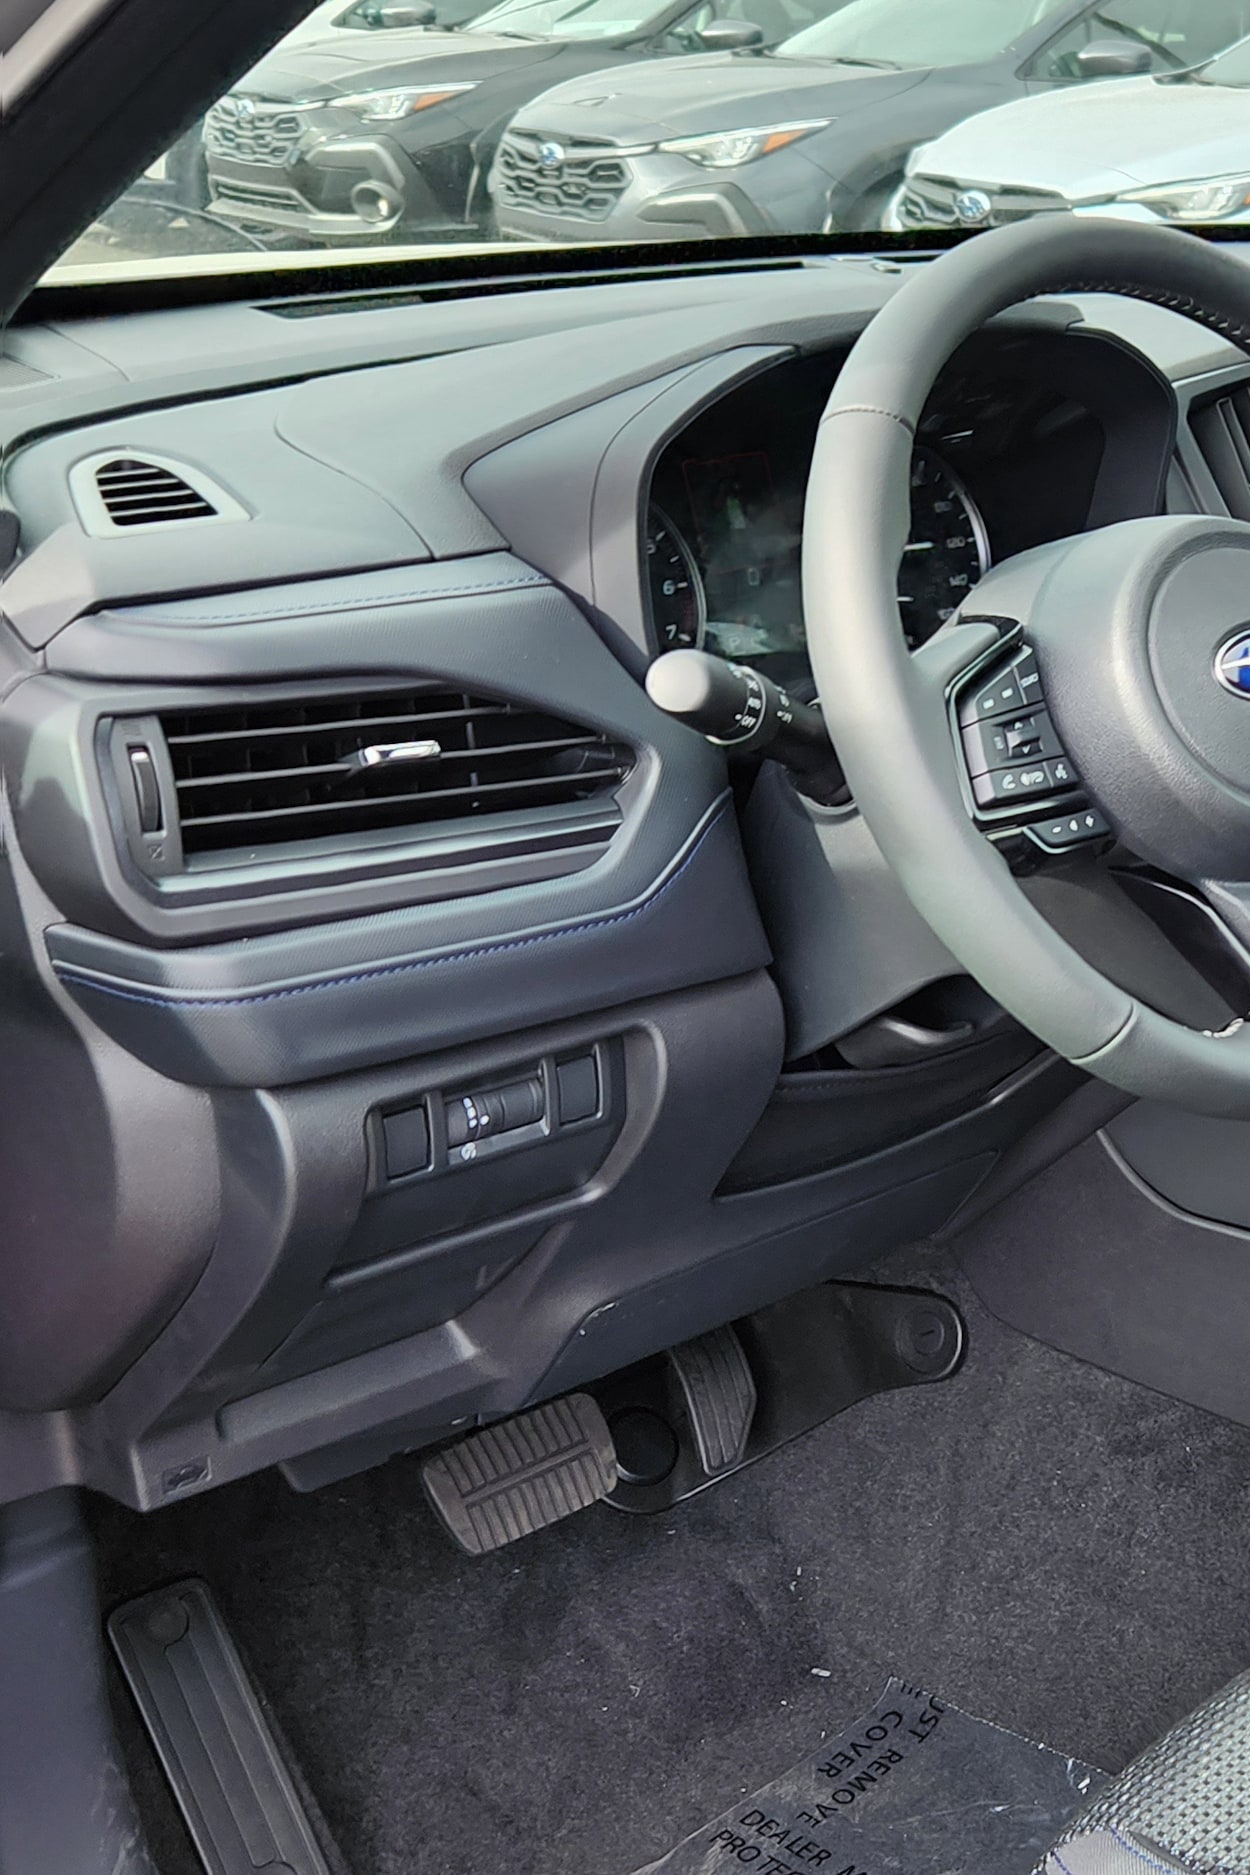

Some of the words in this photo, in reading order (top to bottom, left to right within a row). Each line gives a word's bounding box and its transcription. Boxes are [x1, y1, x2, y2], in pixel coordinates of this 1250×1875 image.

[662, 579, 675, 596] 6
[665, 623, 677, 640] 7
[816, 1710, 904, 1778] COVER
[907, 1694, 945, 1744] UST
[796, 1748, 904, 1829] REMOVE
[739, 1808, 832, 1867] DEALER
